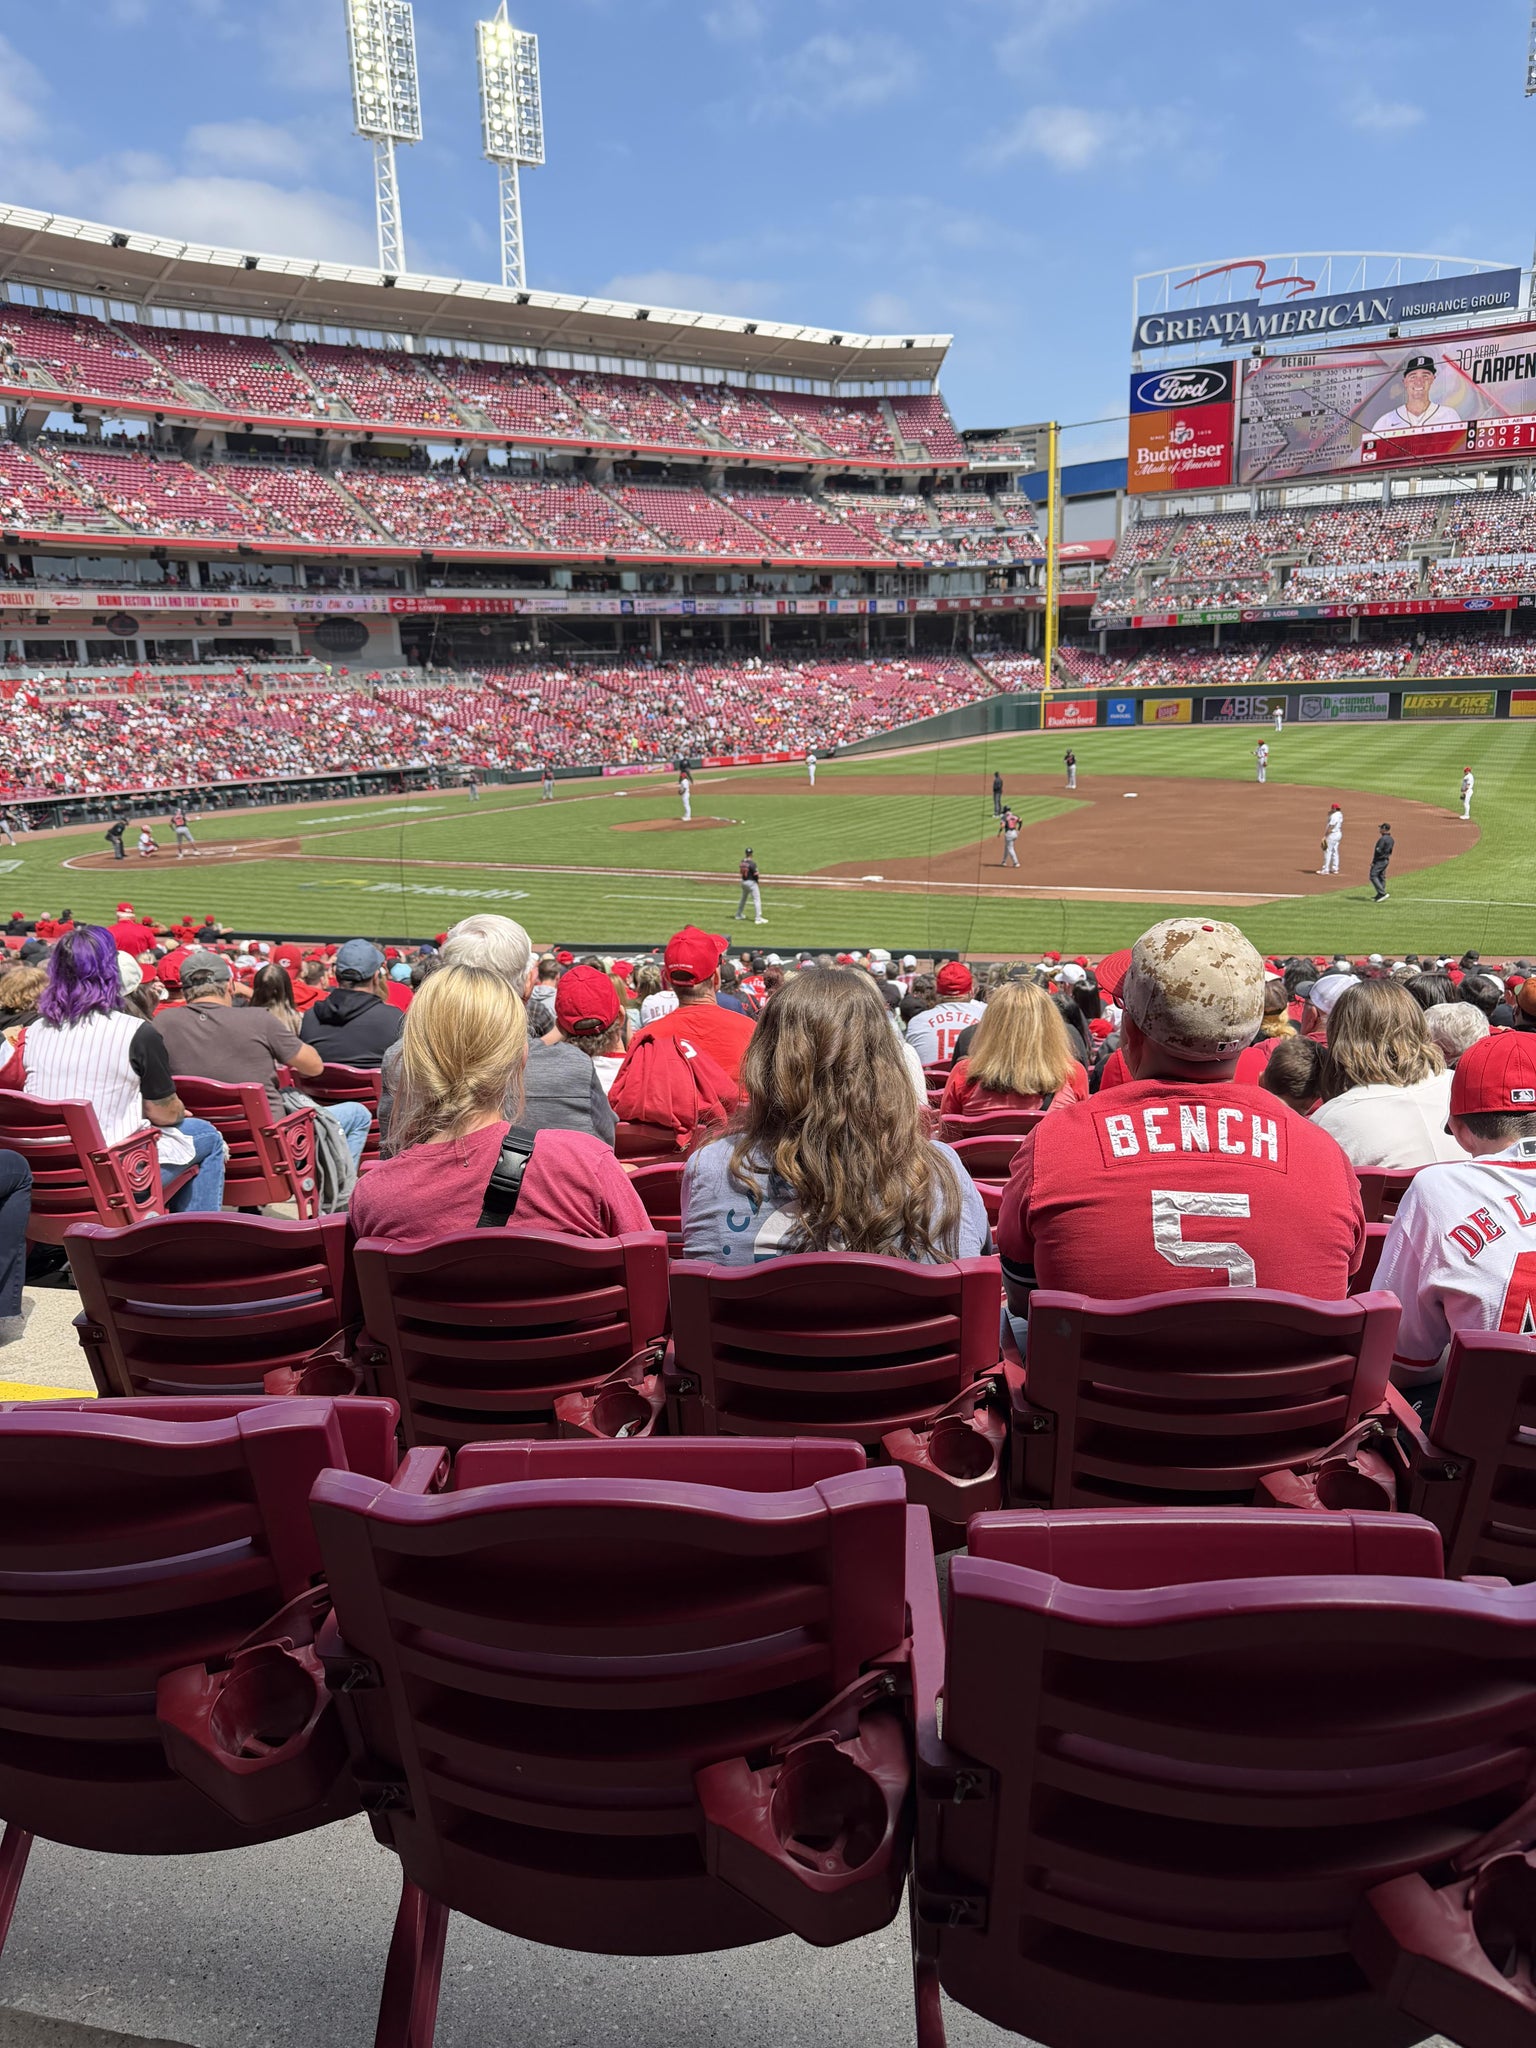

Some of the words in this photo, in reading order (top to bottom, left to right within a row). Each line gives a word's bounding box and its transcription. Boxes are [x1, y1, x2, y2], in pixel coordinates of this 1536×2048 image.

[1401, 297, 1468, 317] INSURANCE
[1471, 291, 1511, 308] GROUP
[1474, 344, 1500, 359] KERRY
[1281, 356, 1317, 368] DETROIT
[1153, 373, 1211, 402] Ford
[1264, 382, 1291, 390] TORRES
[1468, 429, 1475, 438] 0
[1478, 428, 1485, 437] 2
[1488, 427, 1495, 436] 0
[1500, 426, 1507, 435] 0
[1513, 425, 1521, 434] 2
[1467, 440, 1474, 449] 0
[1478, 439, 1485, 448] 0
[1487, 438, 1494, 447] 0
[1499, 437, 1506, 446] 0
[1513, 436, 1520, 445] 2
[1136, 443, 1225, 465] Budweiser
[1134, 462, 1167, 476] Made
[1168, 461, 1180, 475] of
[1177, 458, 1222, 473] America
[24, 594, 35, 605] KY
[124, 596, 152, 607] SECTION
[1220, 696, 1269, 717] 4BIS
[1404, 696, 1448, 709] WEST
[1449, 694, 1489, 708] LAKE
[1331, 703, 1387, 718] Destruction
[1105, 1105, 1279, 1163] BENCH
[1151, 1190, 1257, 1288] 5
[1450, 1207, 1506, 1260] DE
